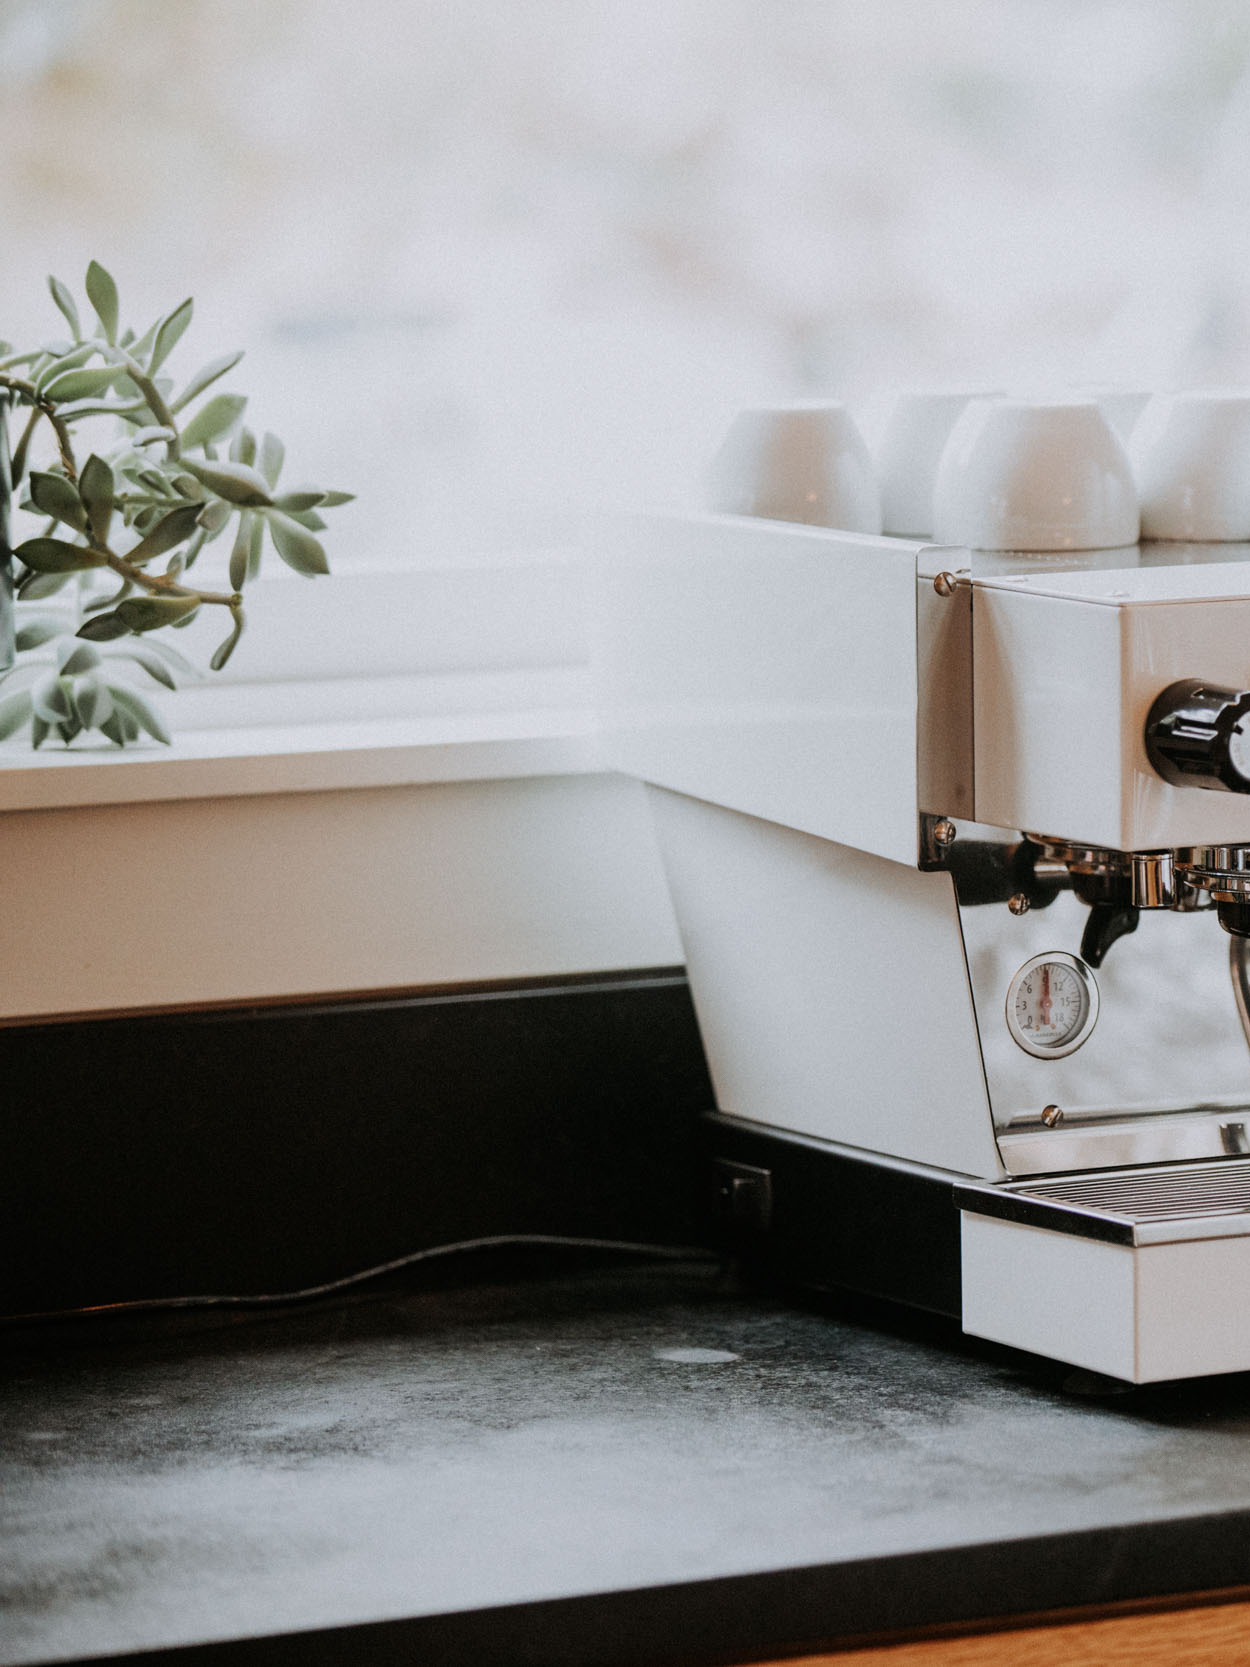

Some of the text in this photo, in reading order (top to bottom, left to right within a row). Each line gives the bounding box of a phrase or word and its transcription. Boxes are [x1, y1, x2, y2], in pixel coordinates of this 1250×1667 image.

[1027, 984, 1032, 994] 6
[1053, 981, 1063, 991] 12
[1022, 1000, 1027, 1011] 3
[1060, 996, 1071, 1007] 15
[1027, 1015, 1032, 1025] 0
